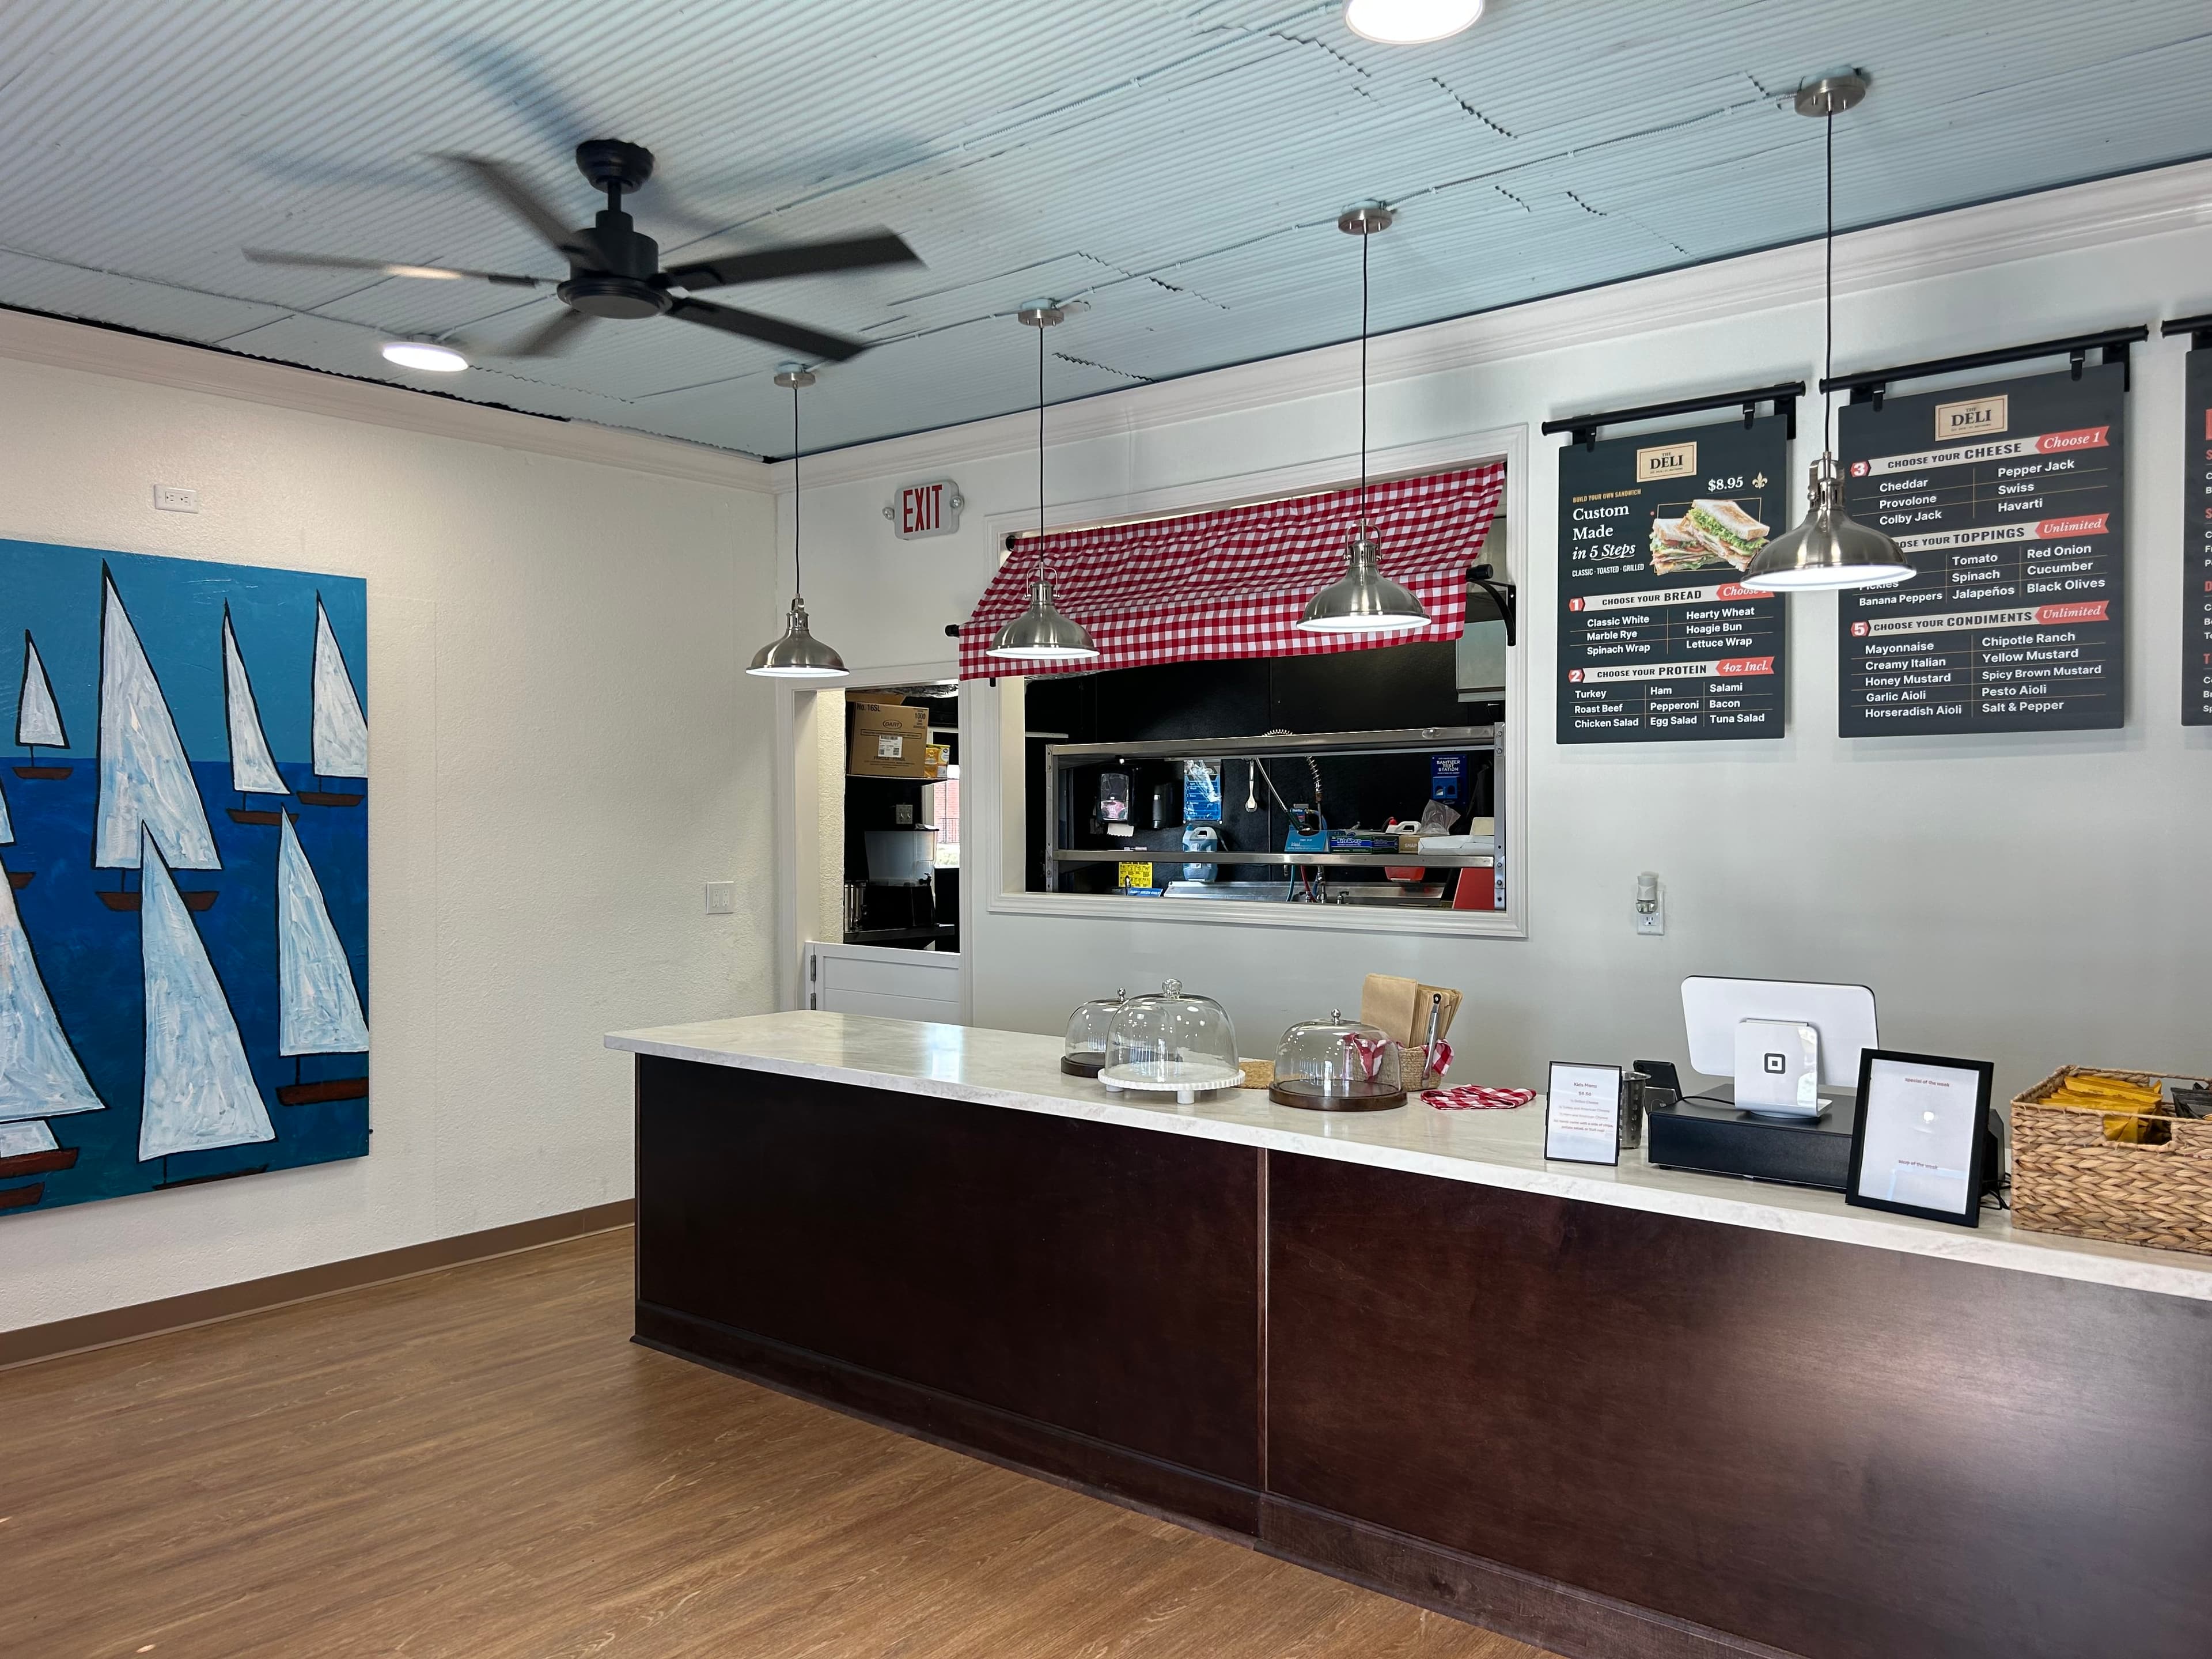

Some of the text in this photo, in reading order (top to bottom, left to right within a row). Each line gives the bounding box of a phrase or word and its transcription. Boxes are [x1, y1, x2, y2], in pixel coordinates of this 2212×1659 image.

[1952, 410, 1991, 426] DELI
[2044, 432, 2099, 448] Choose 1
[1651, 455, 1682, 469] DELI
[1854, 443, 2021, 476] 3 CHOOSE YOUR CHEESE
[1998, 460, 2074, 477] Pepper Jack
[1709, 477, 1743, 491] $8.95
[1880, 479, 1928, 491] Cheddar
[1998, 483, 2034, 494] Swiss
[1615, 488, 1641, 498] SANDWICH
[903, 484, 942, 533] EXIT
[1880, 496, 1936, 509] Provolone
[1999, 498, 2042, 512] Havarti
[1573, 506, 1629, 520] Custom
[1880, 510, 1941, 525] Colby Jack
[2044, 518, 2101, 533] Unlimited
[1573, 525, 1613, 540] Made
[1922, 537, 1950, 546] YOUR
[1953, 528, 2024, 544] TOPPINGS
[1572, 543, 1636, 560] in 5 Steps
[2028, 545, 2091, 558] Red Onion
[1952, 554, 1998, 565] Tomato
[1573, 569, 1593, 577] CLASSIC
[1597, 566, 1619, 574] TOASTED
[2028, 562, 2093, 574] Cucumber
[1952, 570, 1999, 584] Spinach
[2028, 579, 2105, 593] Black Olives
[1953, 586, 2014, 599] Jalapeños
[1573, 599, 1581, 610] 1
[1665, 591, 1701, 601] BREAD
[1860, 593, 1942, 605] Banana Peppers
[1687, 607, 1754, 619] Hearty Wheat
[2043, 605, 2101, 618] Unlimited
[1588, 615, 1649, 627] Classic White
[1854, 622, 1865, 635] 5
[1874, 622, 1912, 631] CHOOSE
[1947, 612, 2032, 626] CONDIMENTS
[1687, 624, 1720, 634] Hoagie
[1588, 631, 1637, 641] Marble Rye
[1982, 632, 2075, 647] Chipotle Ranch
[1687, 638, 1752, 648] Lettuce Wrap
[1866, 642, 1934, 655] Mayonnaise
[1588, 644, 1650, 656] Spinach Wrap
[1983, 649, 2078, 662] Yellow Mustard
[1723, 660, 1768, 672] 4oz Incl.
[1866, 658, 1945, 670] Creamy Italian
[1571, 671, 1581, 681] 2
[1659, 665, 1706, 675] PROTEIN
[1982, 671, 2012, 681] Spicy
[2054, 665, 2101, 675] Mustard
[1866, 673, 1950, 686] Honey Mustard
[1651, 687, 1672, 695] Ham
[1710, 683, 1742, 692] Salami
[1982, 685, 2046, 696] Pesto Aioli
[1575, 690, 1607, 699] Turkey
[1866, 691, 1925, 702] Garlic Aioli
[1603, 704, 1623, 712] Beef
[1651, 700, 1699, 711] Pepperoni
[1710, 700, 1740, 708] Bacon
[1983, 702, 2064, 712] Salt & Pepper
[1866, 705, 1961, 717] Horseradish Aioli
[1575, 718, 1638, 728] Chicken Salad
[1651, 716, 1696, 726] Egg Salad
[1737, 714, 1764, 722] Salad
